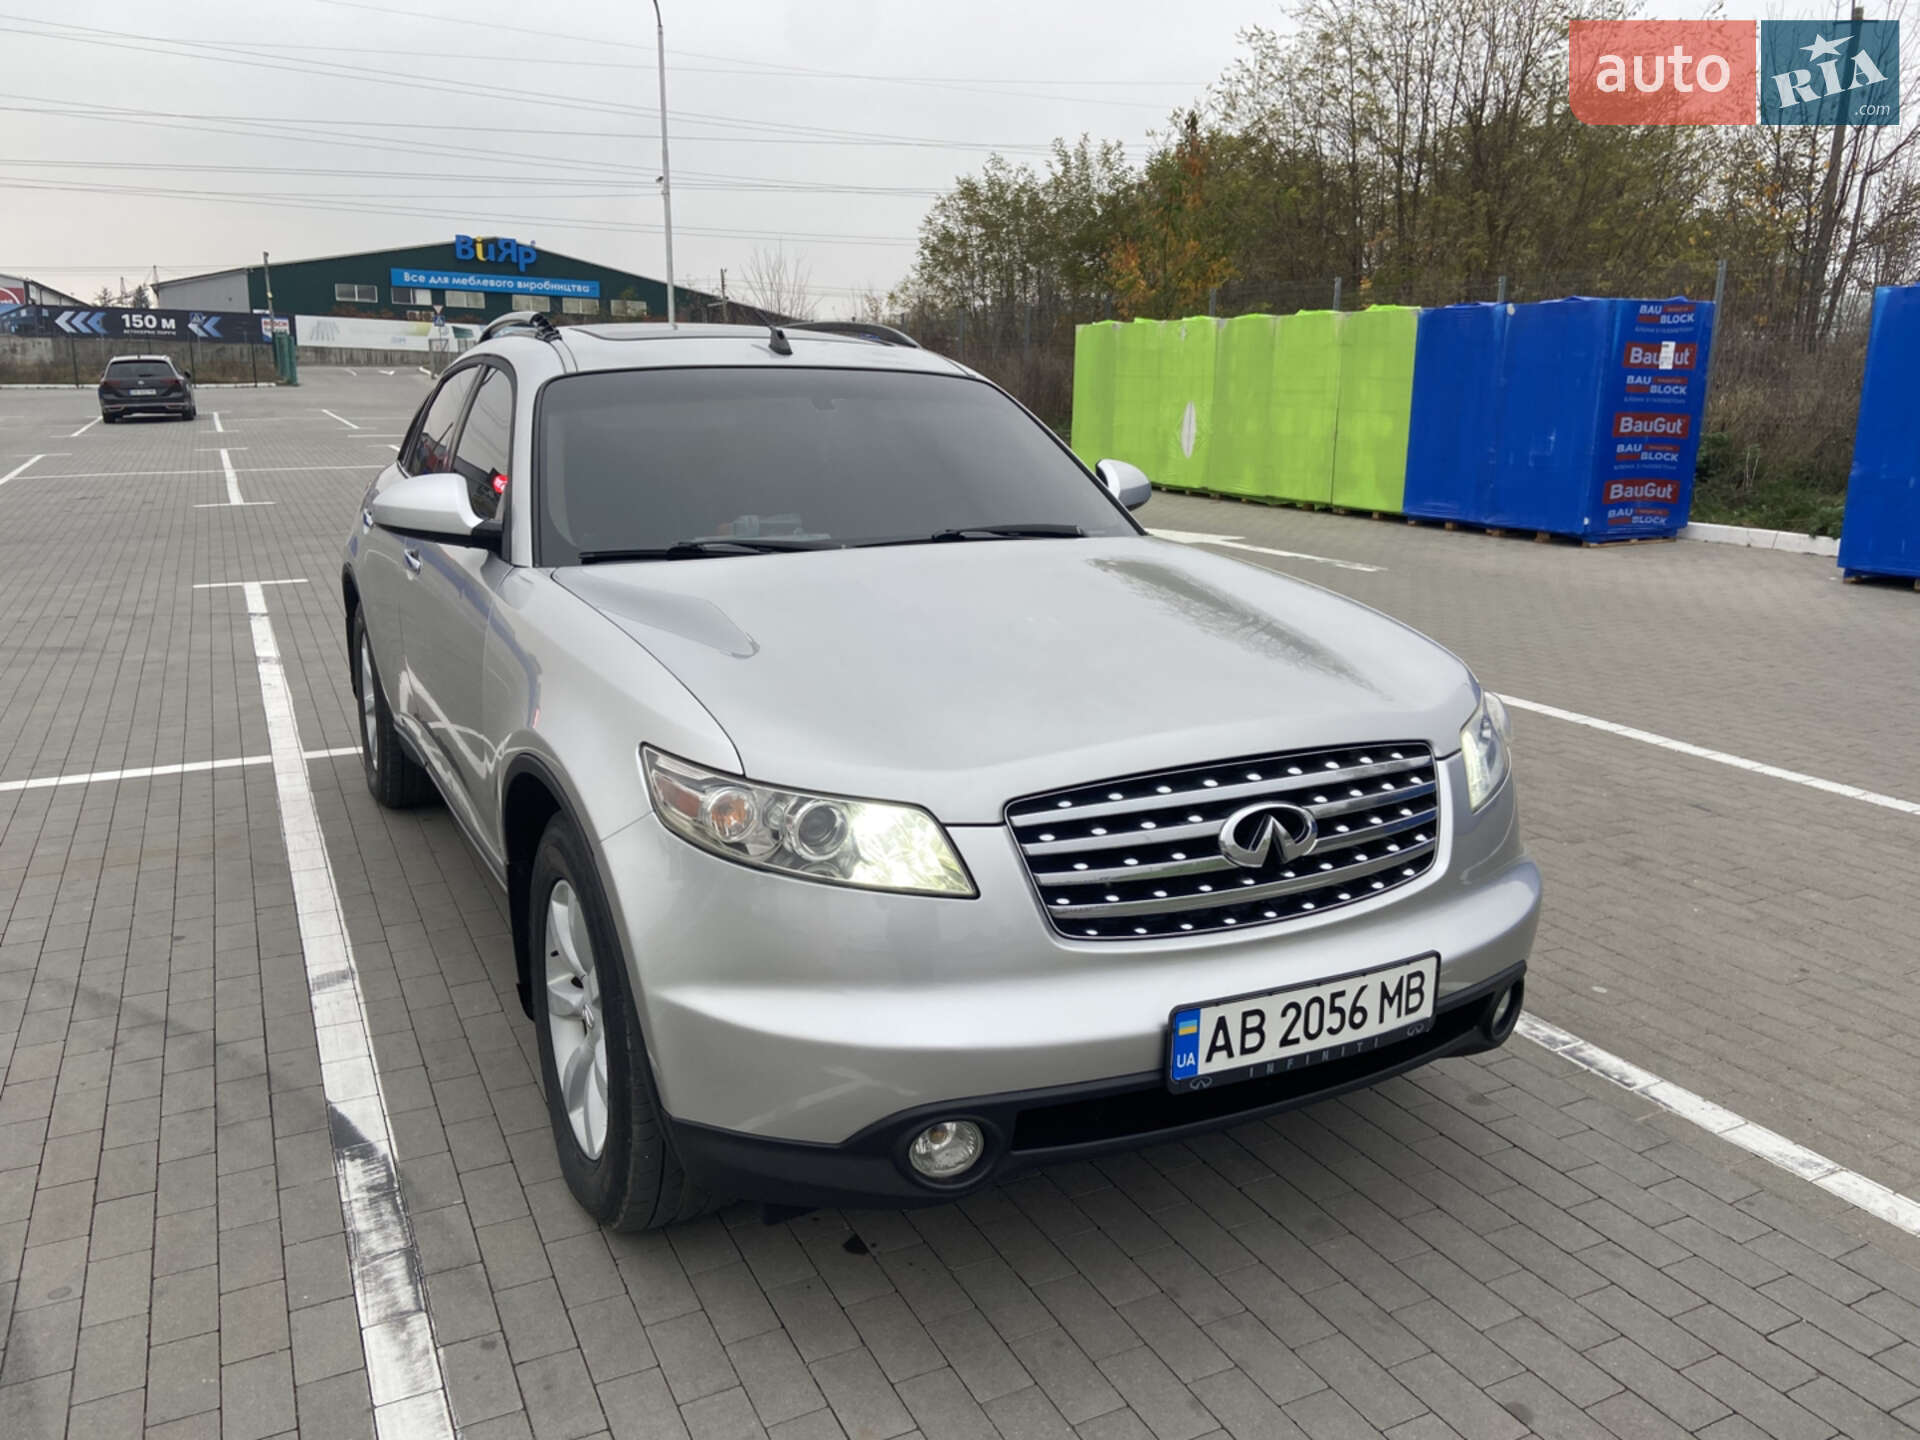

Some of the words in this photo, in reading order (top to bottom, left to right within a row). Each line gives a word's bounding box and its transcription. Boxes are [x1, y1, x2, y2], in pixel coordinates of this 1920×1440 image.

[403, 271, 425, 283] Все
[428, 275, 449, 285] для
[452, 276, 514, 289] меблевого
[516, 280, 591, 294] виробництва
[1639, 304, 1662, 314] BAU
[120, 313, 157, 329] 150
[1660, 313, 1695, 324] BLOCK
[1629, 346, 1690, 366] Bauut
[1626, 375, 1652, 385] BAU
[1649, 384, 1688, 395] BLOCK
[1619, 417, 1683, 434] BauGut
[1616, 444, 1642, 453] BAU
[1640, 452, 1679, 462] BLOCK
[1609, 482, 1673, 500] BauGut
[1607, 508, 1633, 518] BAU
[1631, 515, 1667, 525] BLOCK
[1176, 1052, 1196, 1068] UA
[1205, 1008, 1266, 1063] AB
[1278, 984, 1368, 1048] 2056
[1378, 970, 1426, 1025] MB
[1250, 1037, 1380, 1079] INFINITI
